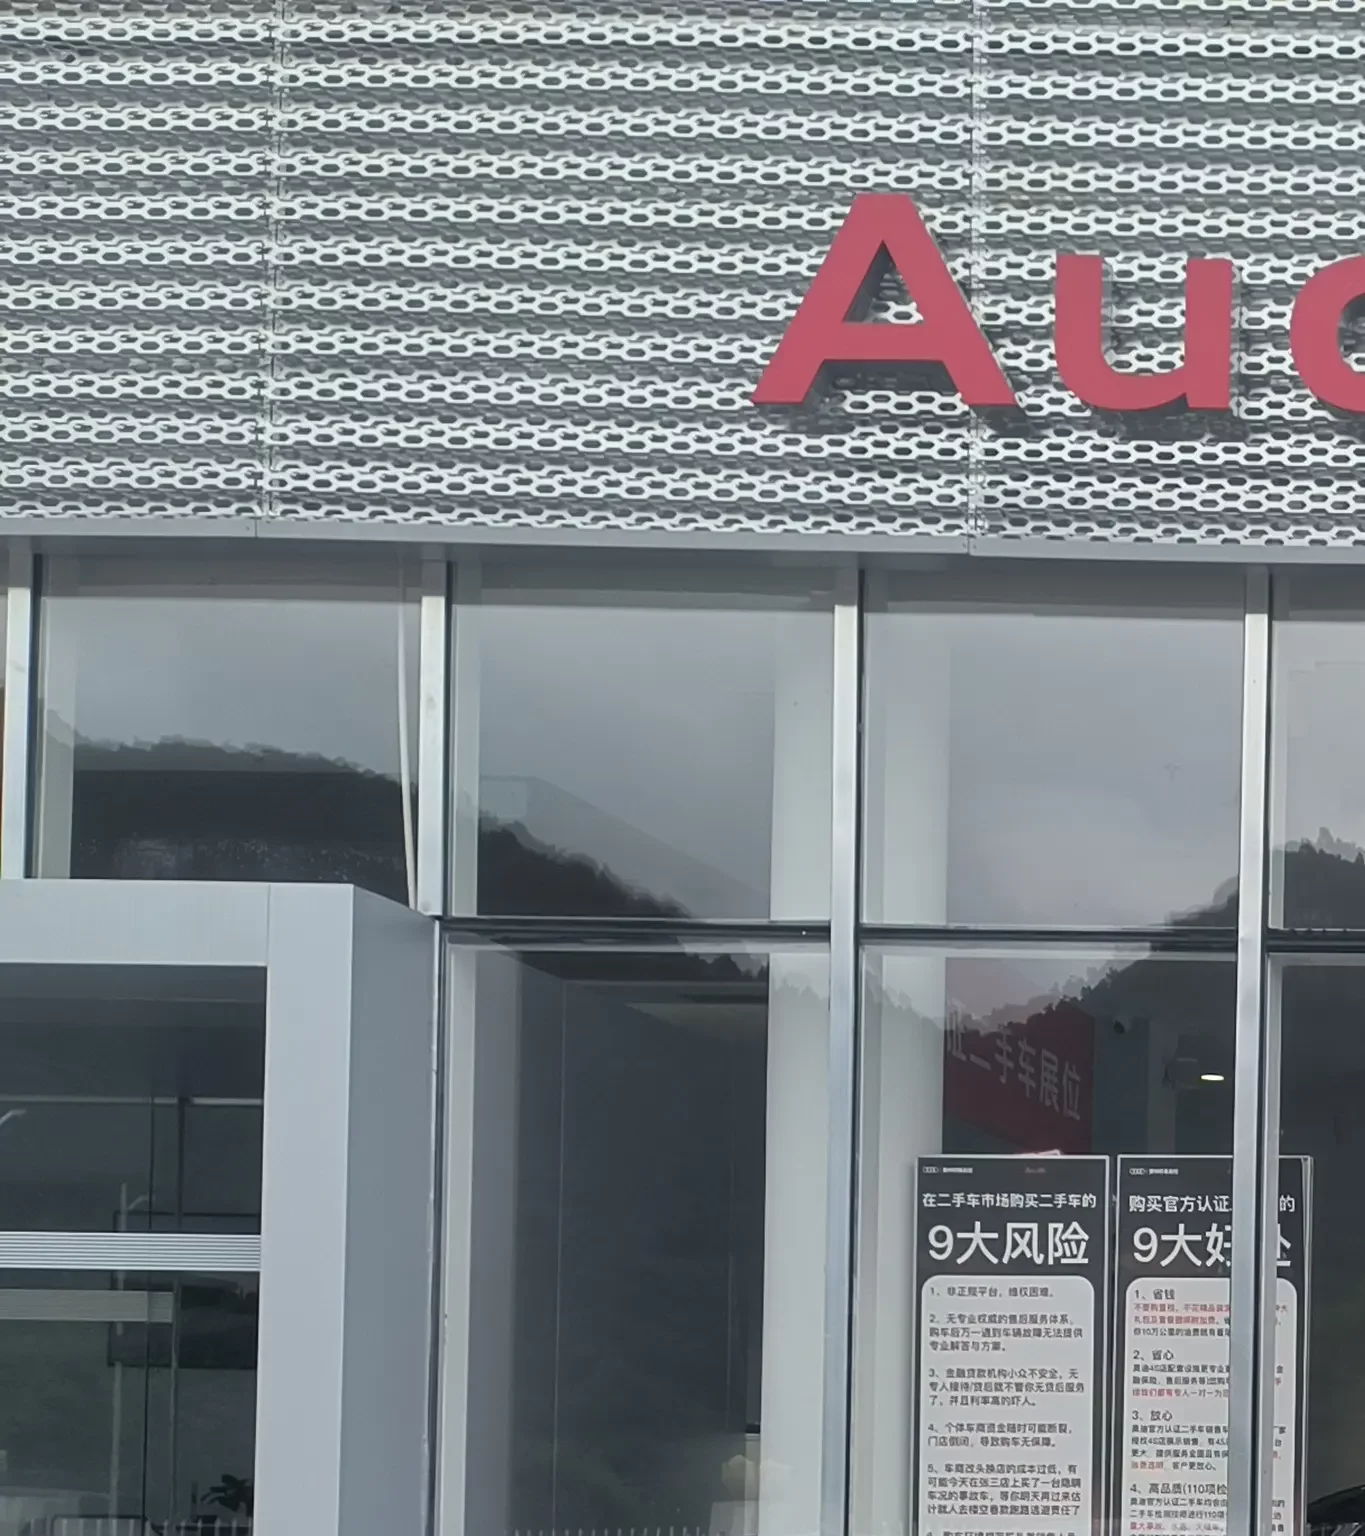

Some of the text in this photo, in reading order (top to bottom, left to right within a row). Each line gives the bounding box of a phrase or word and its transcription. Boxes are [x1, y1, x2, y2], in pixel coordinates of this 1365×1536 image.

[922, 1192, 1097, 1209] 在二手车市场购买二手车的
[1128, 1195, 1296, 1213] 购买官方认证的
[928, 1221, 1090, 1265] 9大风险
